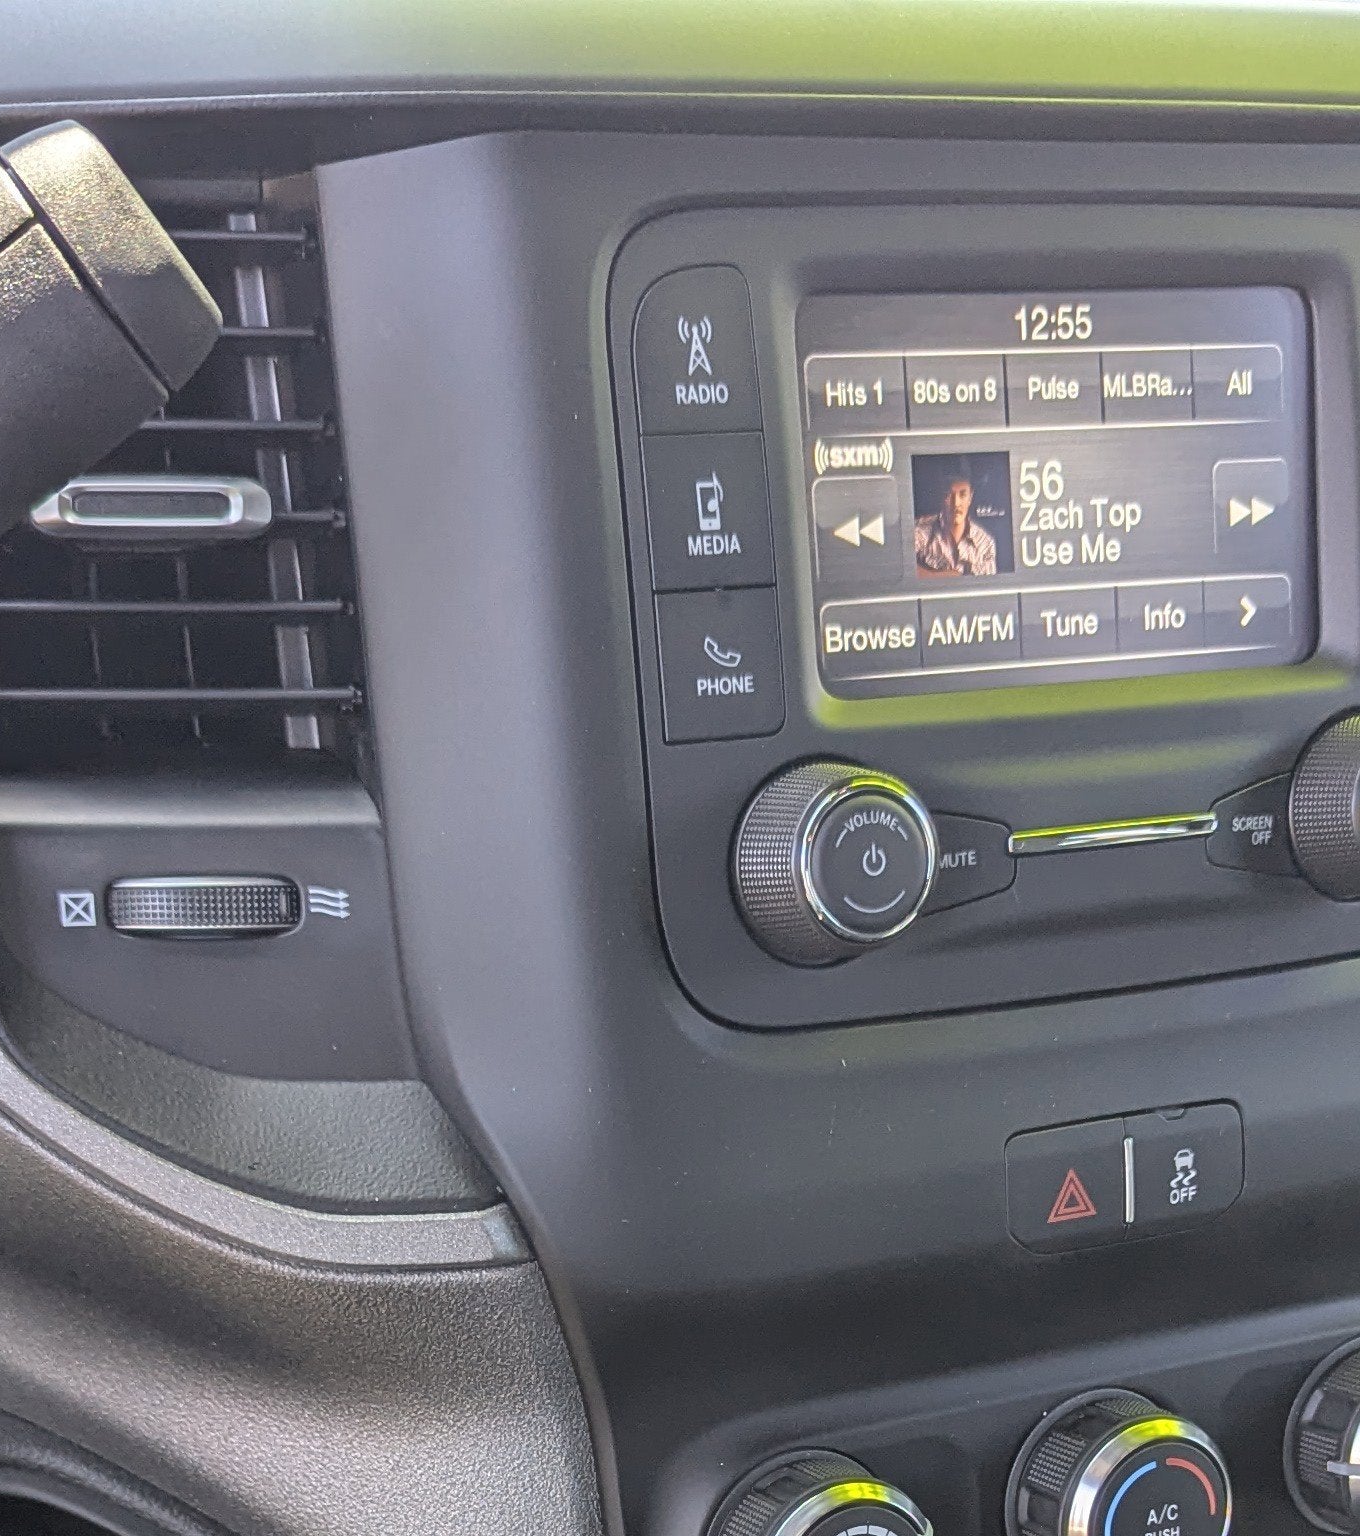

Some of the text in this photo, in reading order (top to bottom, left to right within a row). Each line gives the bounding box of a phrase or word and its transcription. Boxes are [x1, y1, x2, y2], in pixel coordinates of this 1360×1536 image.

[1014, 304, 1093, 341] 12:55
[675, 384, 729, 405] RADIO
[825, 379, 884, 407] Hits 1
[913, 378, 997, 404] 80s on 8
[1027, 376, 1080, 400] Pulse
[1103, 372, 1194, 398] MLBRa...
[1226, 369, 1254, 396] All
[829, 445, 880, 469] sxm
[1019, 460, 1064, 502] 56
[1019, 498, 1142, 535] Zach Top
[687, 533, 742, 557] MEDIA
[1021, 532, 1122, 567] Use Me
[1040, 608, 1100, 638] Tune
[1143, 602, 1187, 632] Info
[824, 622, 917, 655] Browse
[928, 616, 1016, 647] AM/FM
[696, 675, 755, 697] PHONE
[843, 809, 899, 833] VOLUME
[1232, 815, 1274, 833] SCREEN
[1251, 830, 1272, 846] OFF
[939, 851, 978, 869] MUTE
[1169, 1185, 1197, 1204] OFF
[1146, 1503, 1179, 1526] A/C
